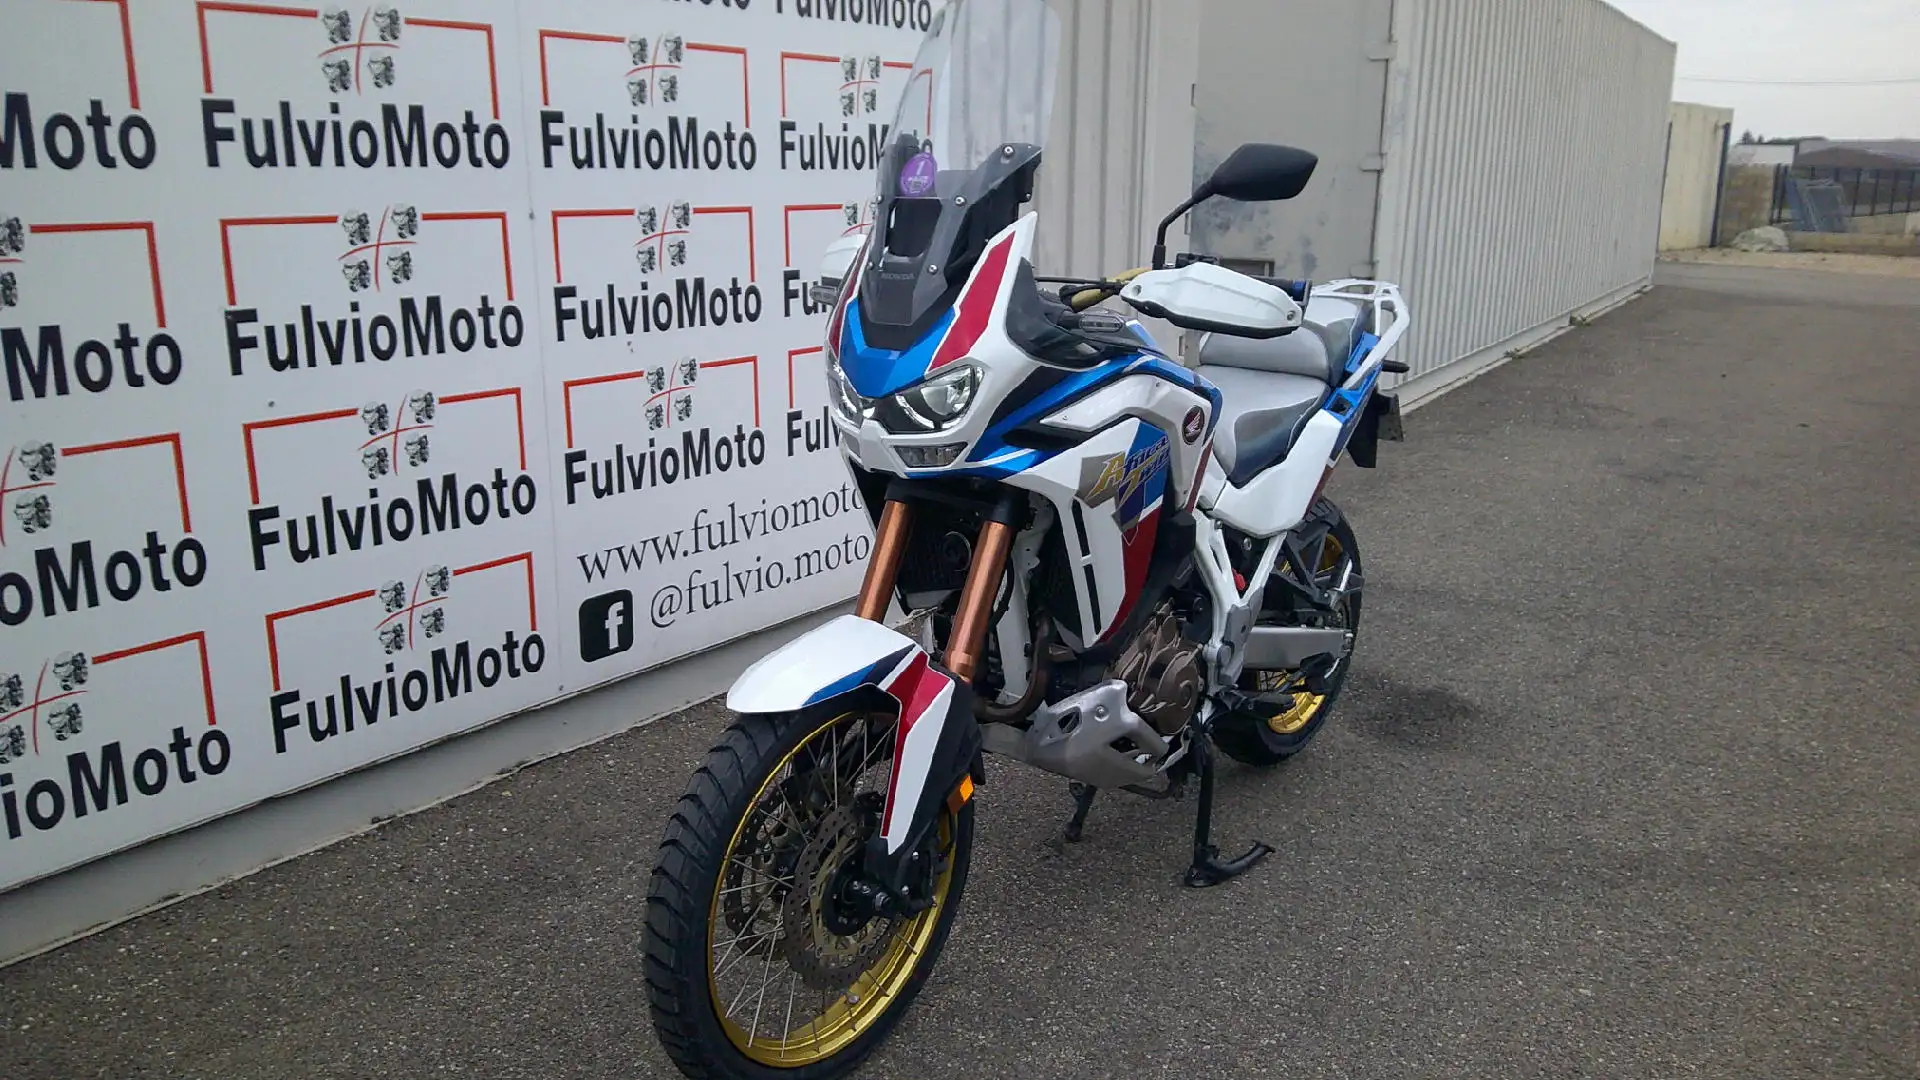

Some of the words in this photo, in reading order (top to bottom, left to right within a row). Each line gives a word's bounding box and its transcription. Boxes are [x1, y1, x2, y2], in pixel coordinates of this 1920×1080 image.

[201, 98, 510, 170] FulvioMoto
[540, 109, 757, 171] FulvioMoto
[225, 295, 524, 377] FulvioMoto
[553, 276, 762, 342] FulvioMoto
[0, 323, 182, 402] Moto
[564, 424, 766, 505] FulvioMoto
[248, 468, 537, 571] FulvioMoto
[650, 532, 870, 629] @fulvio.moto
[270, 631, 546, 754] FulvioMoto
[1, 726, 231, 840] ioMoto
